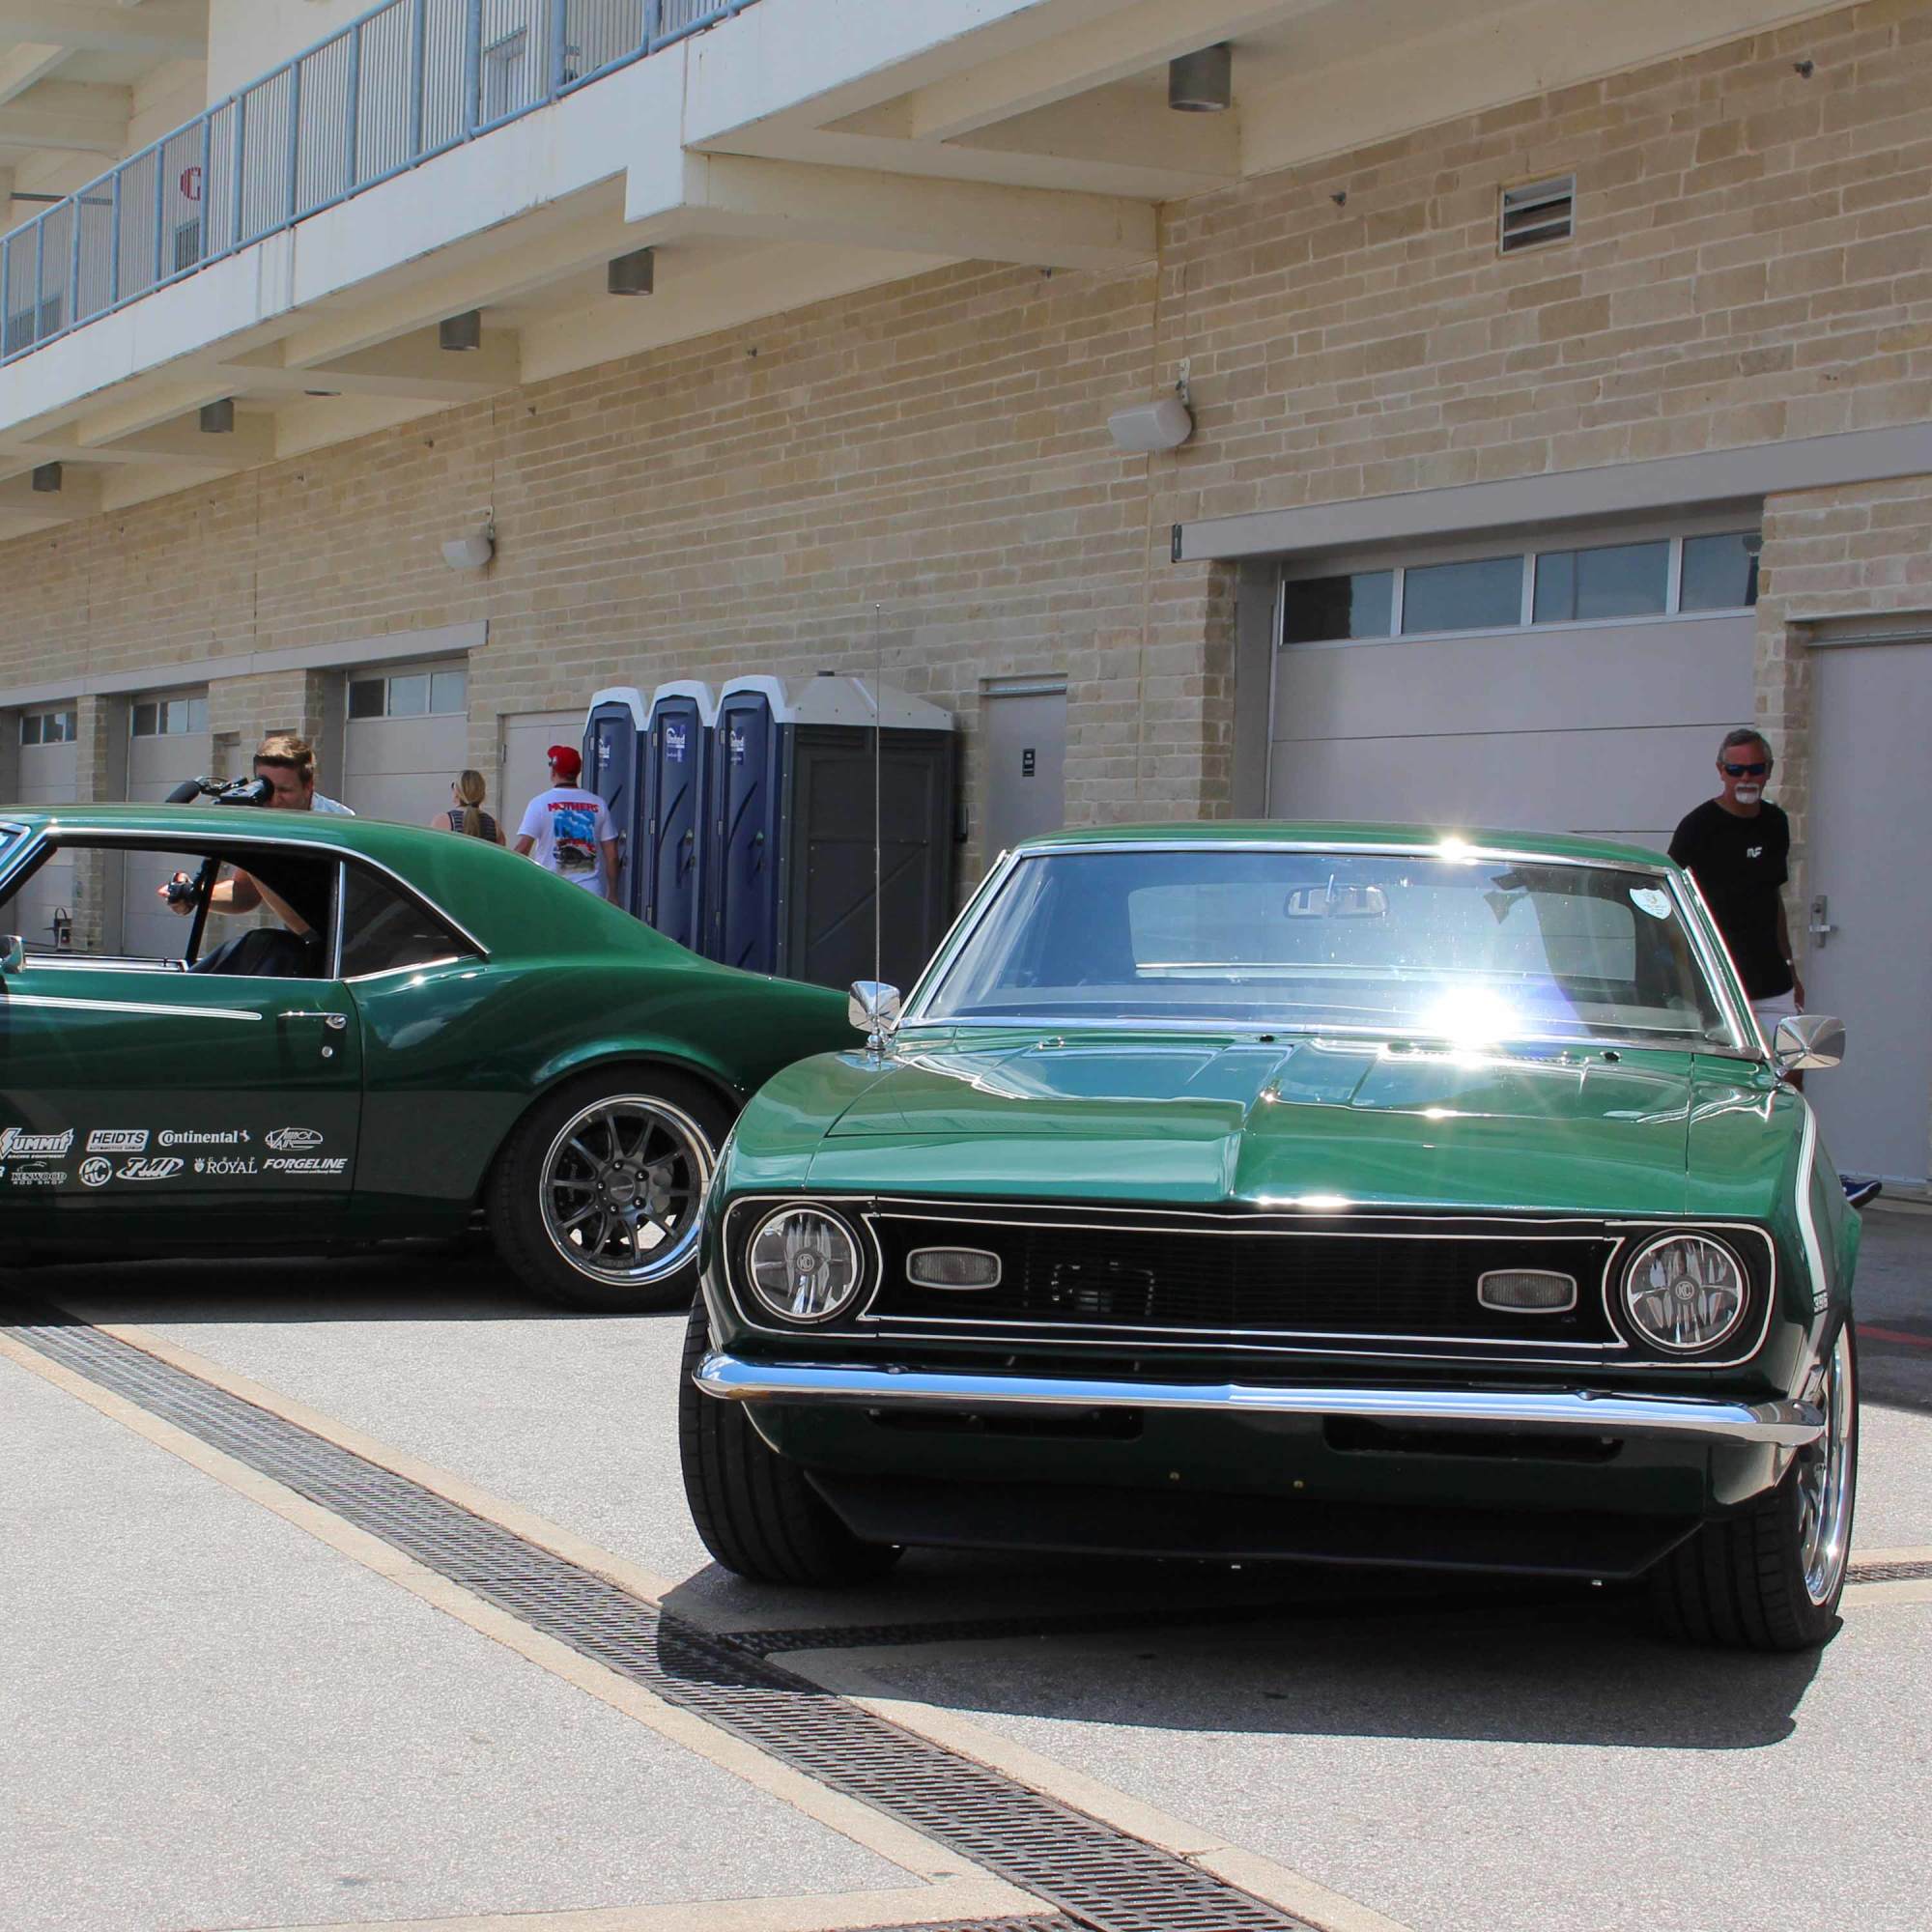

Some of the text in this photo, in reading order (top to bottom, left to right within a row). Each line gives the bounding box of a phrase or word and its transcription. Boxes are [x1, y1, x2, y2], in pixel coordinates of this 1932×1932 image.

[92, 1132, 145, 1144] HEIDTS
[158, 1129, 239, 1147] Continental
[206, 1161, 258, 1174] ROYAL
[264, 1158, 348, 1169] FORGELINE
